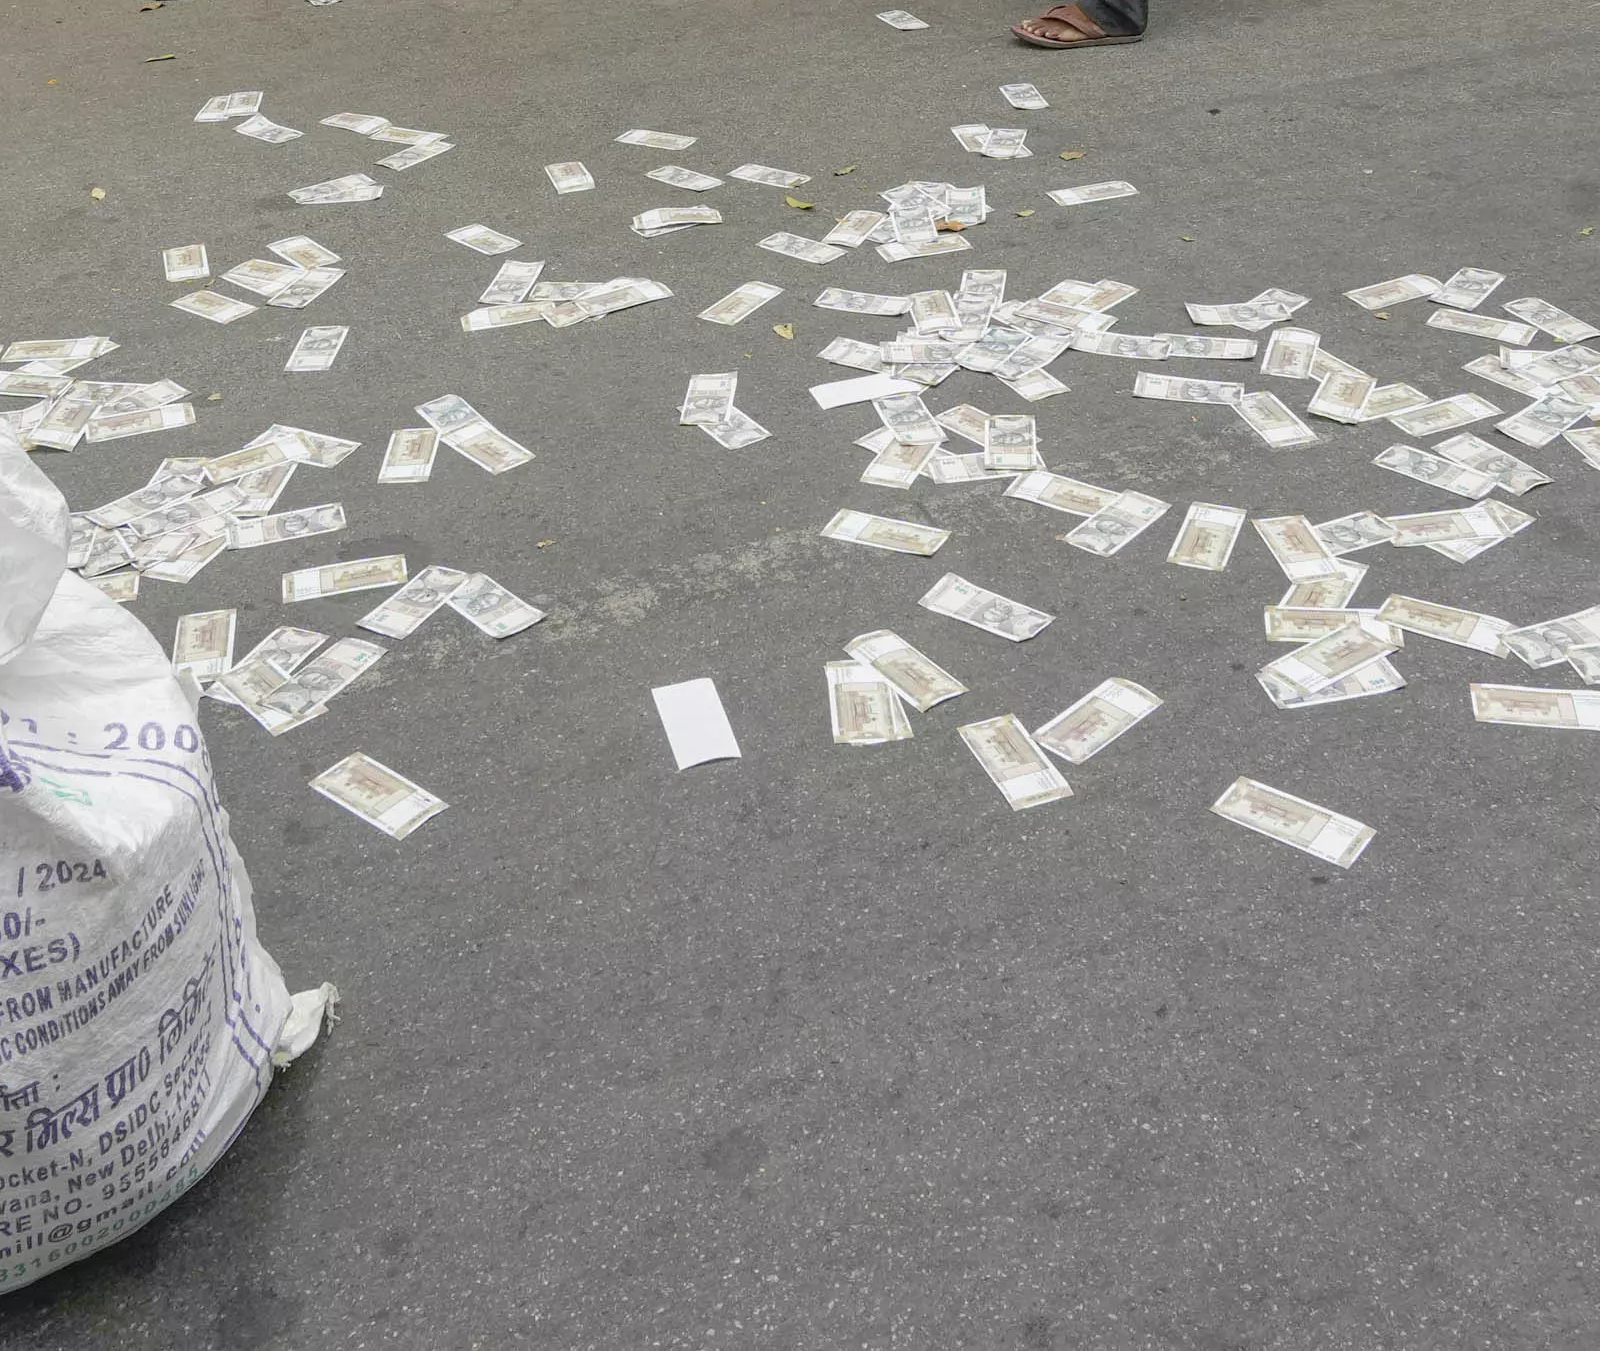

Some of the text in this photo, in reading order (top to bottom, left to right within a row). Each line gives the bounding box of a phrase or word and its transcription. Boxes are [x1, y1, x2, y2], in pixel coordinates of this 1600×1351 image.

[35, 858, 108, 892] 2024
[55, 883, 174, 1003] MANUFACTURE
[14, 991, 107, 1056] CONDITIONS
[99, 1091, 162, 1155] DSIDC
[68, 1160, 116, 1194] New
